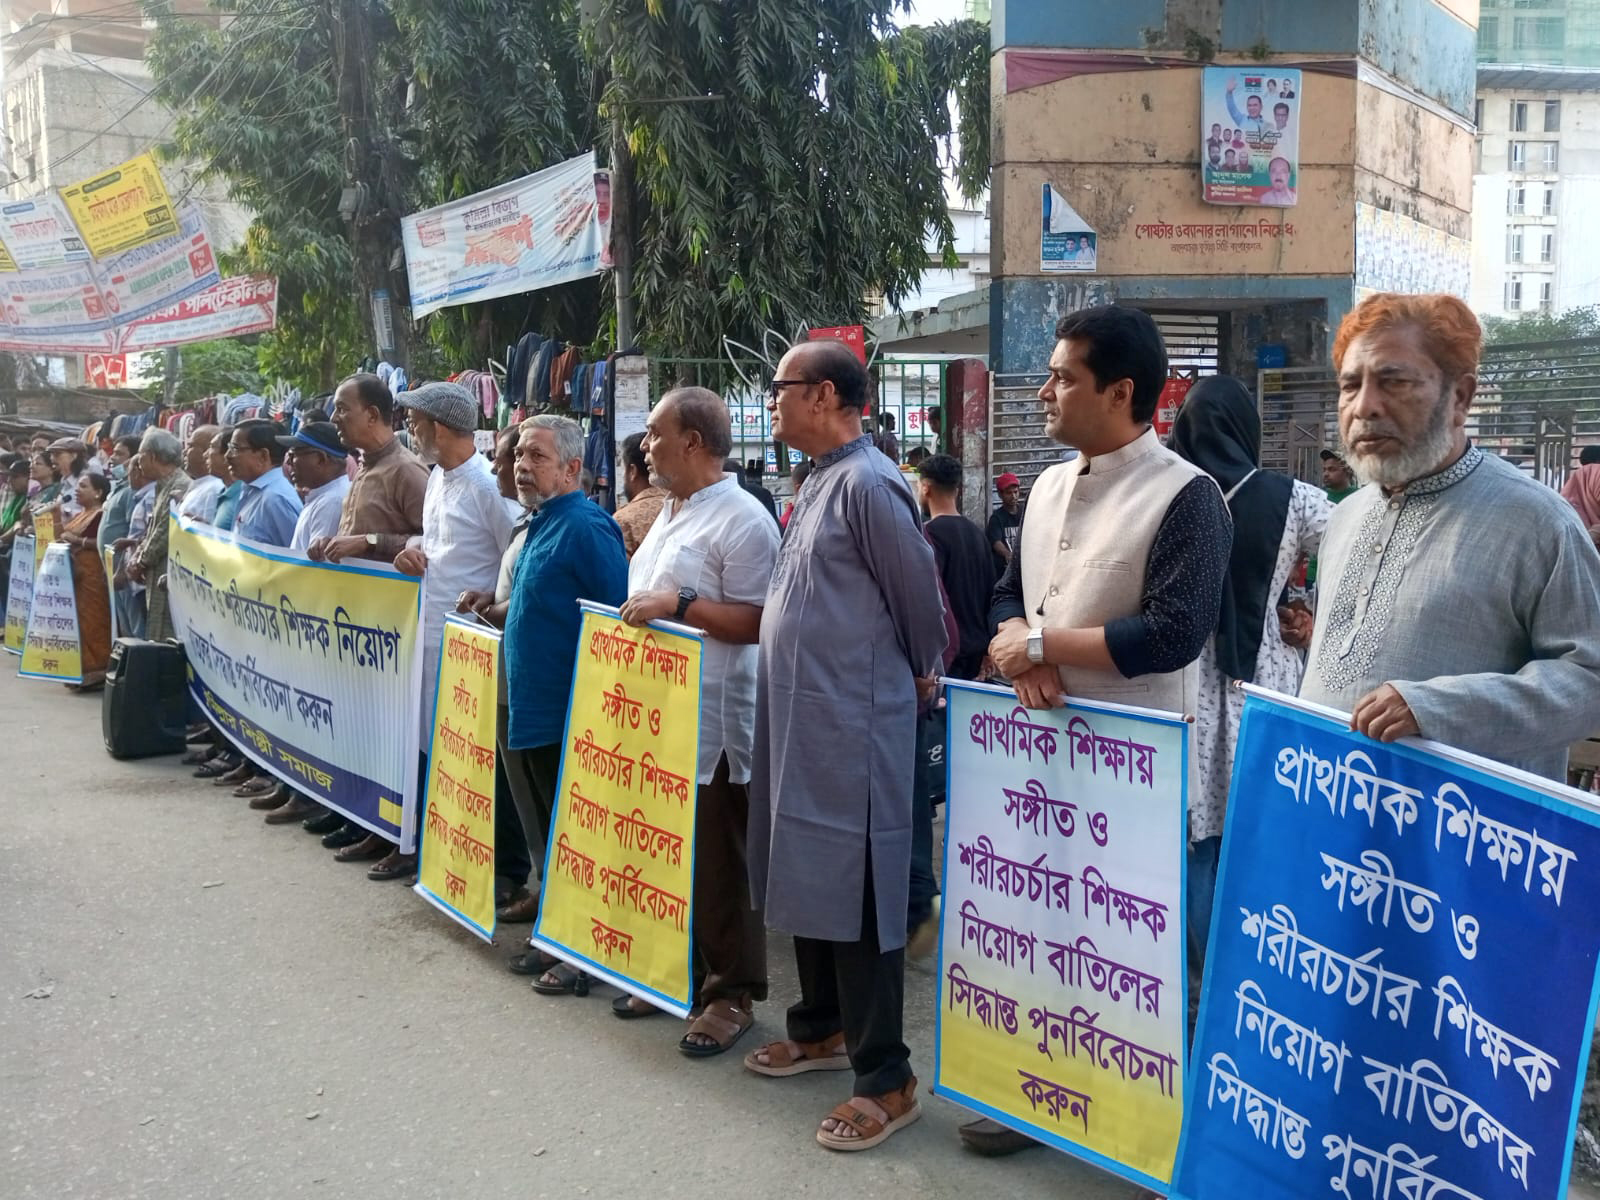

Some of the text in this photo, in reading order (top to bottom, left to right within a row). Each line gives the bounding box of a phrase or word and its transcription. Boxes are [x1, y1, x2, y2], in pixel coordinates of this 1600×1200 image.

[491, 195, 519, 215] বিভাগ
[1175, 224, 1182, 238] ও
[1182, 223, 1212, 239] ব্যানার
[280, 594, 329, 659] শিক্ষক
[333, 606, 401, 675] নিয়োগ
[590, 625, 688, 689] প্রাথমিক শিক্ষায়
[293, 688, 335, 741] করুন
[472, 697, 477, 719] ও
[602, 683, 661, 737] সঙ্গীত ও
[969, 706, 1157, 789] প্রাথমিক শিক্ষায়
[276, 747, 335, 793] সমাজ
[574, 735, 689, 808] শরীরচর্চার শিক্ষক
[570, 782, 683, 868] নিয়োগ বাতিলের
[1003, 778, 1109, 847] সঙ্গীত ও
[1274, 743, 1578, 907] প্রাথমিক শিক্ষায়
[556, 832, 687, 932] সিদ্ধান্ত পুনর্বিবেচনা
[959, 834, 1168, 943] শরীরচর্চার শিক্ষক
[1320, 850, 1480, 960] সঙ্গীত ও
[590, 916, 633, 967] করুন
[959, 900, 1162, 1018] নিয়োগ বাতিলের
[947, 963, 1178, 1099] সিদ্ধান্ত পুনর্বিবেচনা
[1240, 904, 1560, 1102] শরীরচর্চার শিক্ষক
[1017, 1068, 1092, 1135] করুন
[1234, 979, 1537, 1191] নিয়োগ বাতিলের
[1206, 1052, 1484, 1200] সিদ্ধান্ত পুনর্বি
